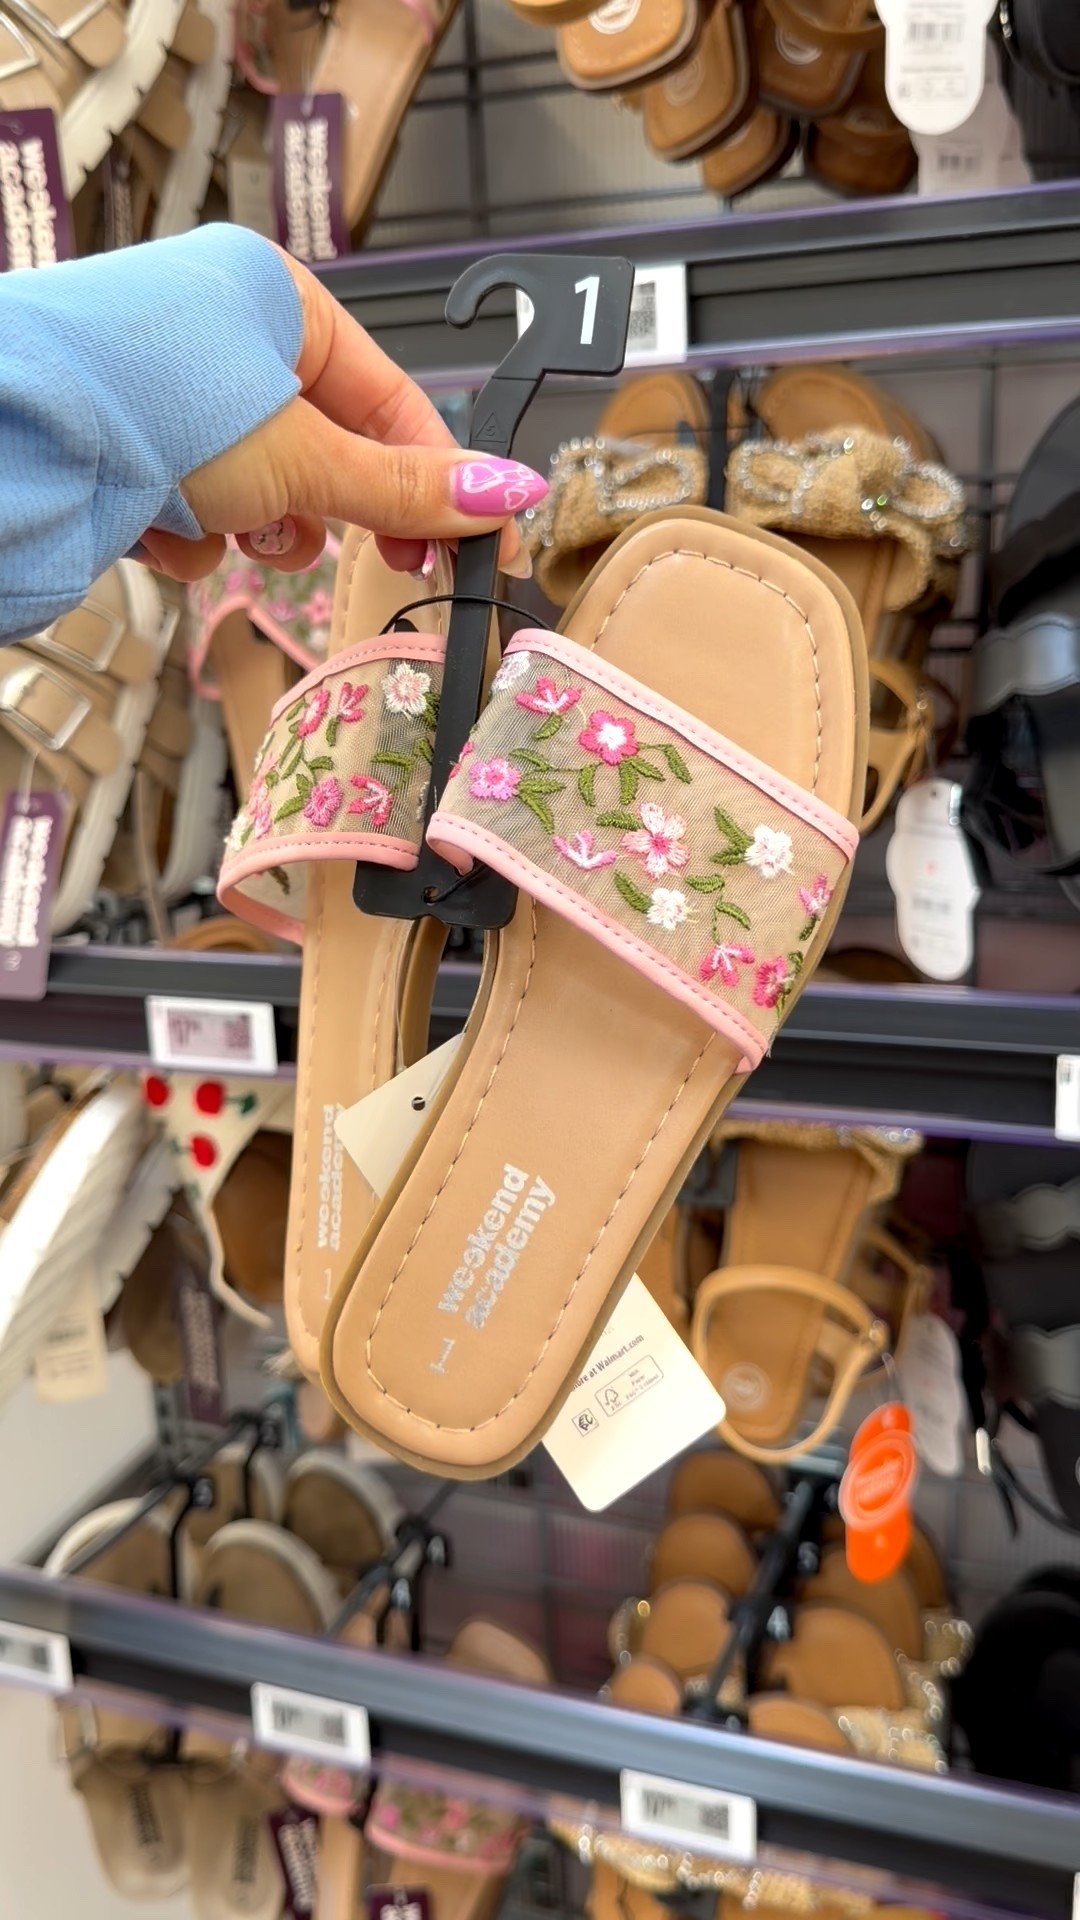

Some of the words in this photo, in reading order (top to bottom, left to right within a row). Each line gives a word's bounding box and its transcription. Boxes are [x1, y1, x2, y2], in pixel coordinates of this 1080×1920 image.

[20, 137, 57, 268] weeken
[306, 118, 338, 260] weekend
[574, 276, 600, 345] 1
[317, 1104, 336, 1249] weekend
[329, 1102, 346, 1252] acadey
[437, 1163, 530, 1314] weekend
[465, 1175, 556, 1330] academy
[430, 1338, 456, 1374] 1
[589, 1367, 598, 1378] at
[595, 1334, 645, 1372] Walmart.com
